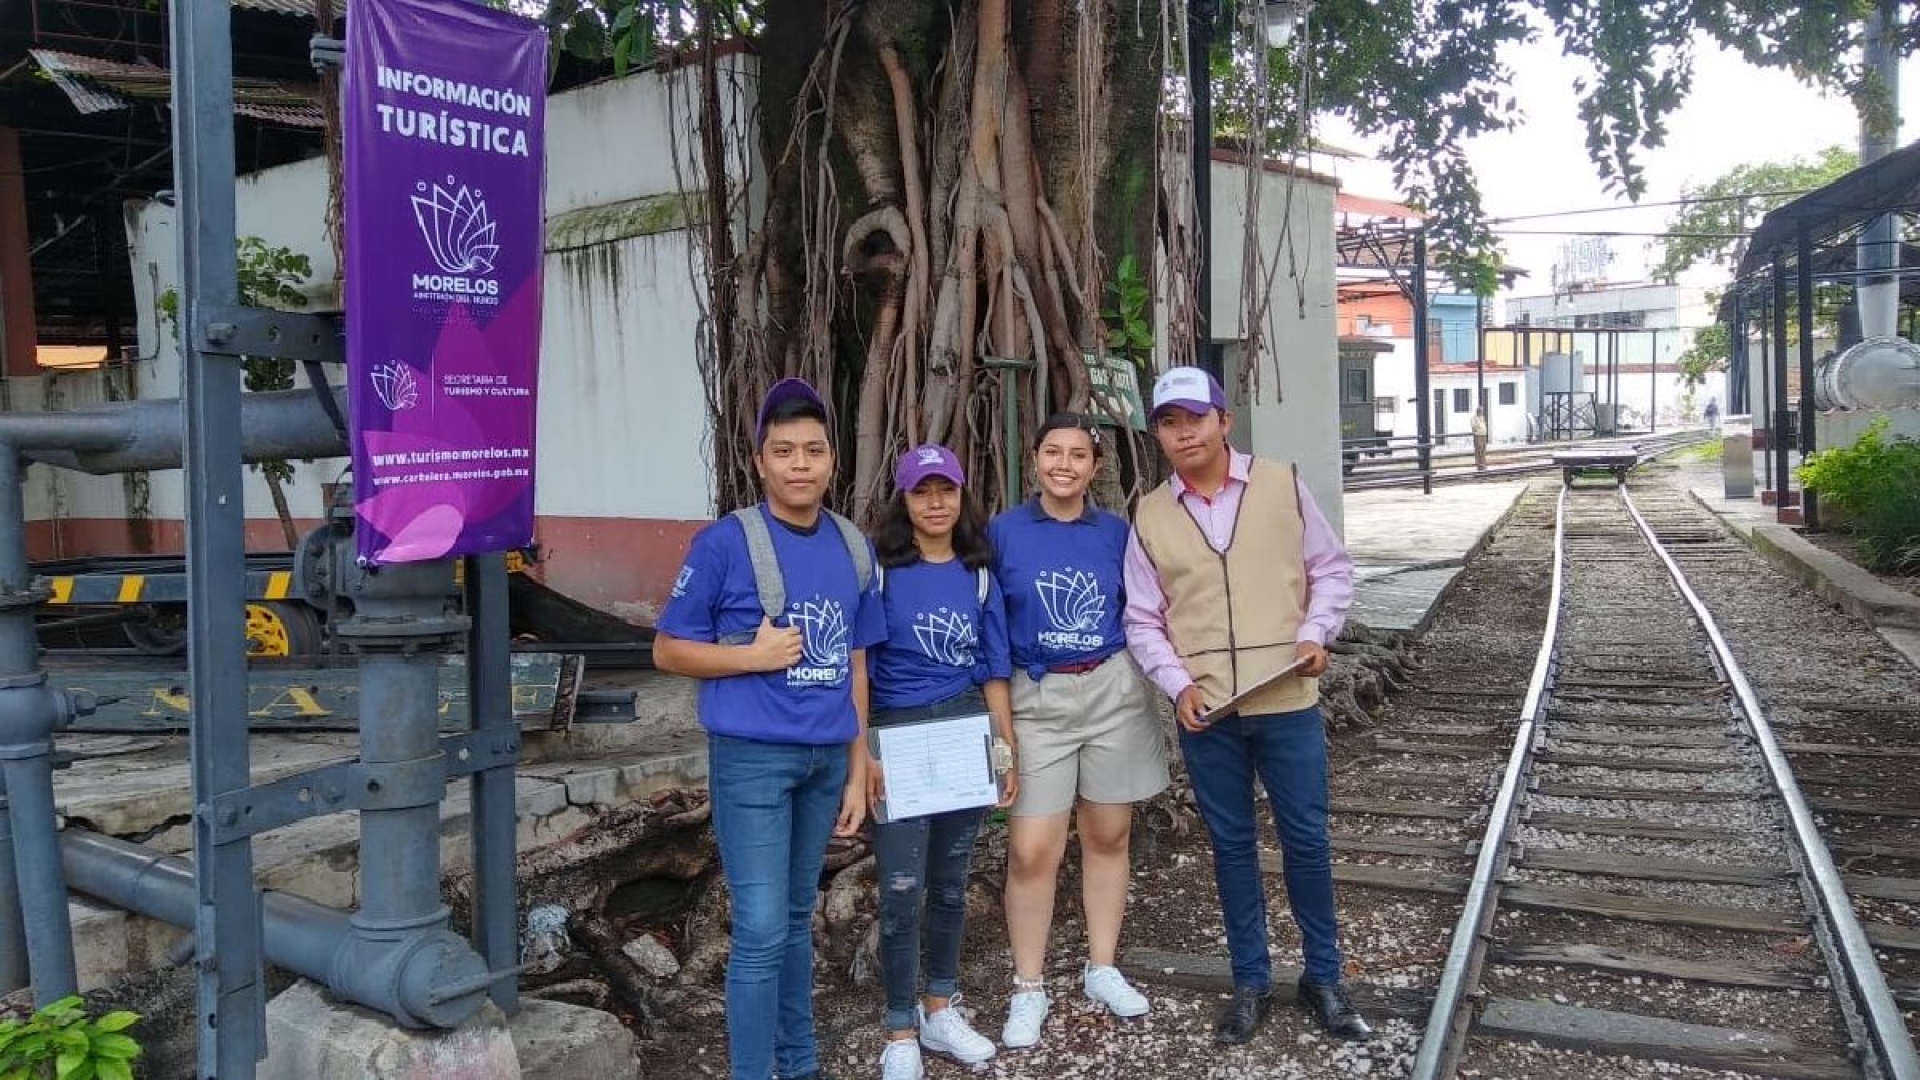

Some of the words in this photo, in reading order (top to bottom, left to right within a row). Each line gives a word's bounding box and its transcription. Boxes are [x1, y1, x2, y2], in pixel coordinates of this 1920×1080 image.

[376, 65, 531, 117] INFORMACIÓN
[376, 104, 529, 157] TURÍSTICA
[412, 273, 499, 295] MORELOS
[443, 387, 482, 396] TURISMO
[482, 387, 490, 396] Y
[490, 388, 530, 396] CULTURA
[373, 446, 529, 467] www.turismomorelos.mx
[1037, 631, 1104, 647] MORELOS
